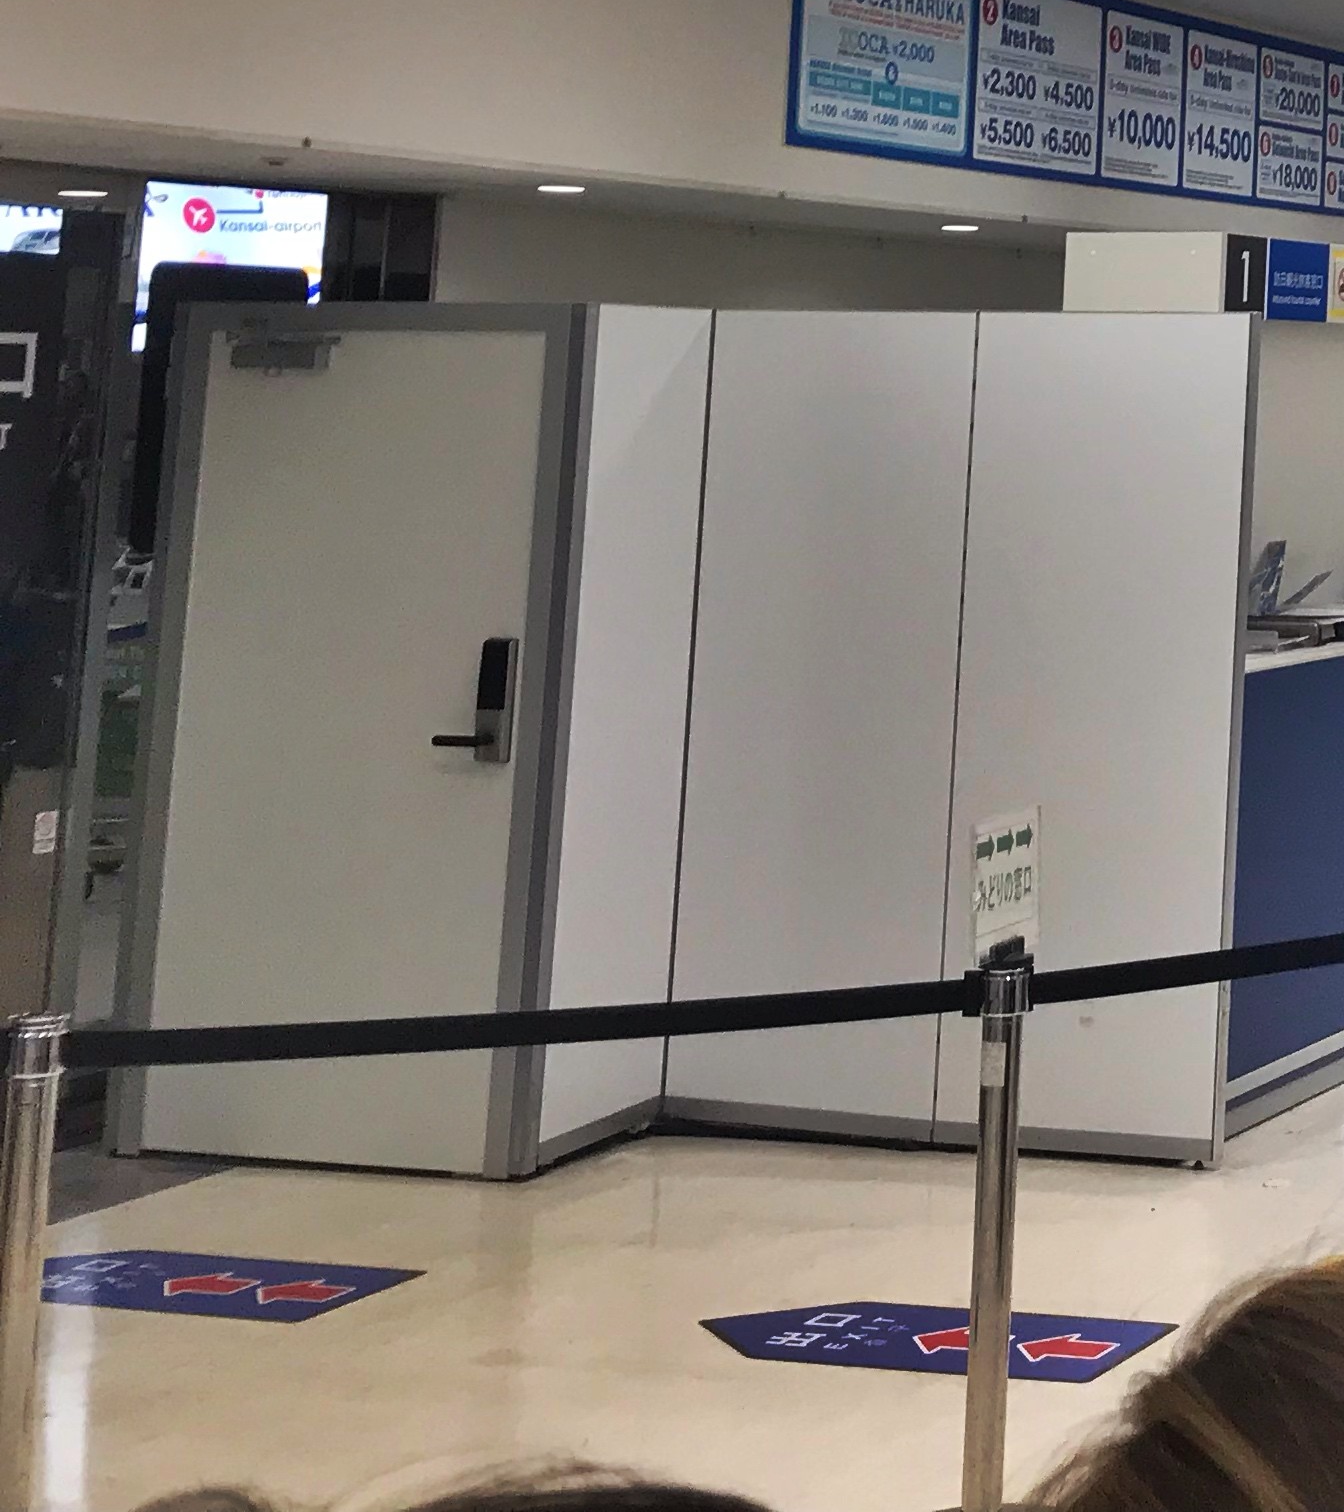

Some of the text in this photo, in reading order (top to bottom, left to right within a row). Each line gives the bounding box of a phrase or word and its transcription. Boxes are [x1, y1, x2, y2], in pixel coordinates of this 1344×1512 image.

[1000, 24, 1054, 55] Area Pass
[1126, 25, 1151, 49] Kansai
[1125, 50, 1161, 77] Area Pass
[983, 68, 1036, 100] ¥2,300
[1044, 80, 1094, 111] ¥4,500
[1276, 87, 1320, 118] ¥20,000
[980, 117, 1034, 148] ¥5,500
[1041, 127, 1092, 157] ¥6,500
[1108, 108, 1176, 150] ¥10,000
[1187, 123, 1252, 163] ¥14,500
[1273, 163, 1317, 191] ¥18,000
[219, 220, 321, 234] Kansai-airport
[1241, 250, 1250, 302] 1
[765, 1312, 862, 1348] 出口
[823, 1317, 896, 1350] EXIT
